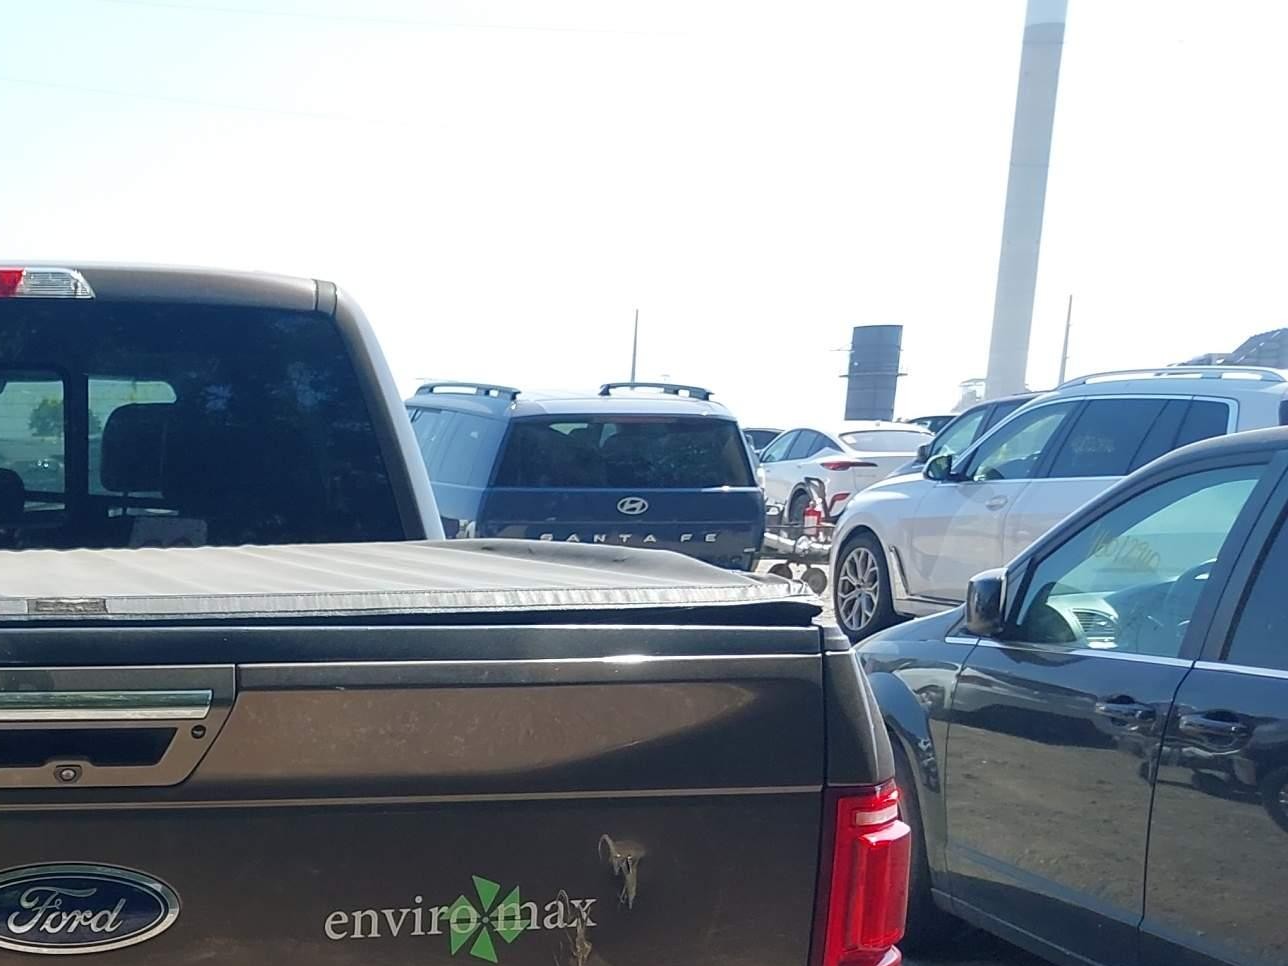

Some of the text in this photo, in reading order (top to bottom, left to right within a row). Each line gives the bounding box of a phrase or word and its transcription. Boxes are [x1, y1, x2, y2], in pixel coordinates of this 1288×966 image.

[539, 533, 717, 543] SANTA FE
[8, 886, 127, 934] Ford
